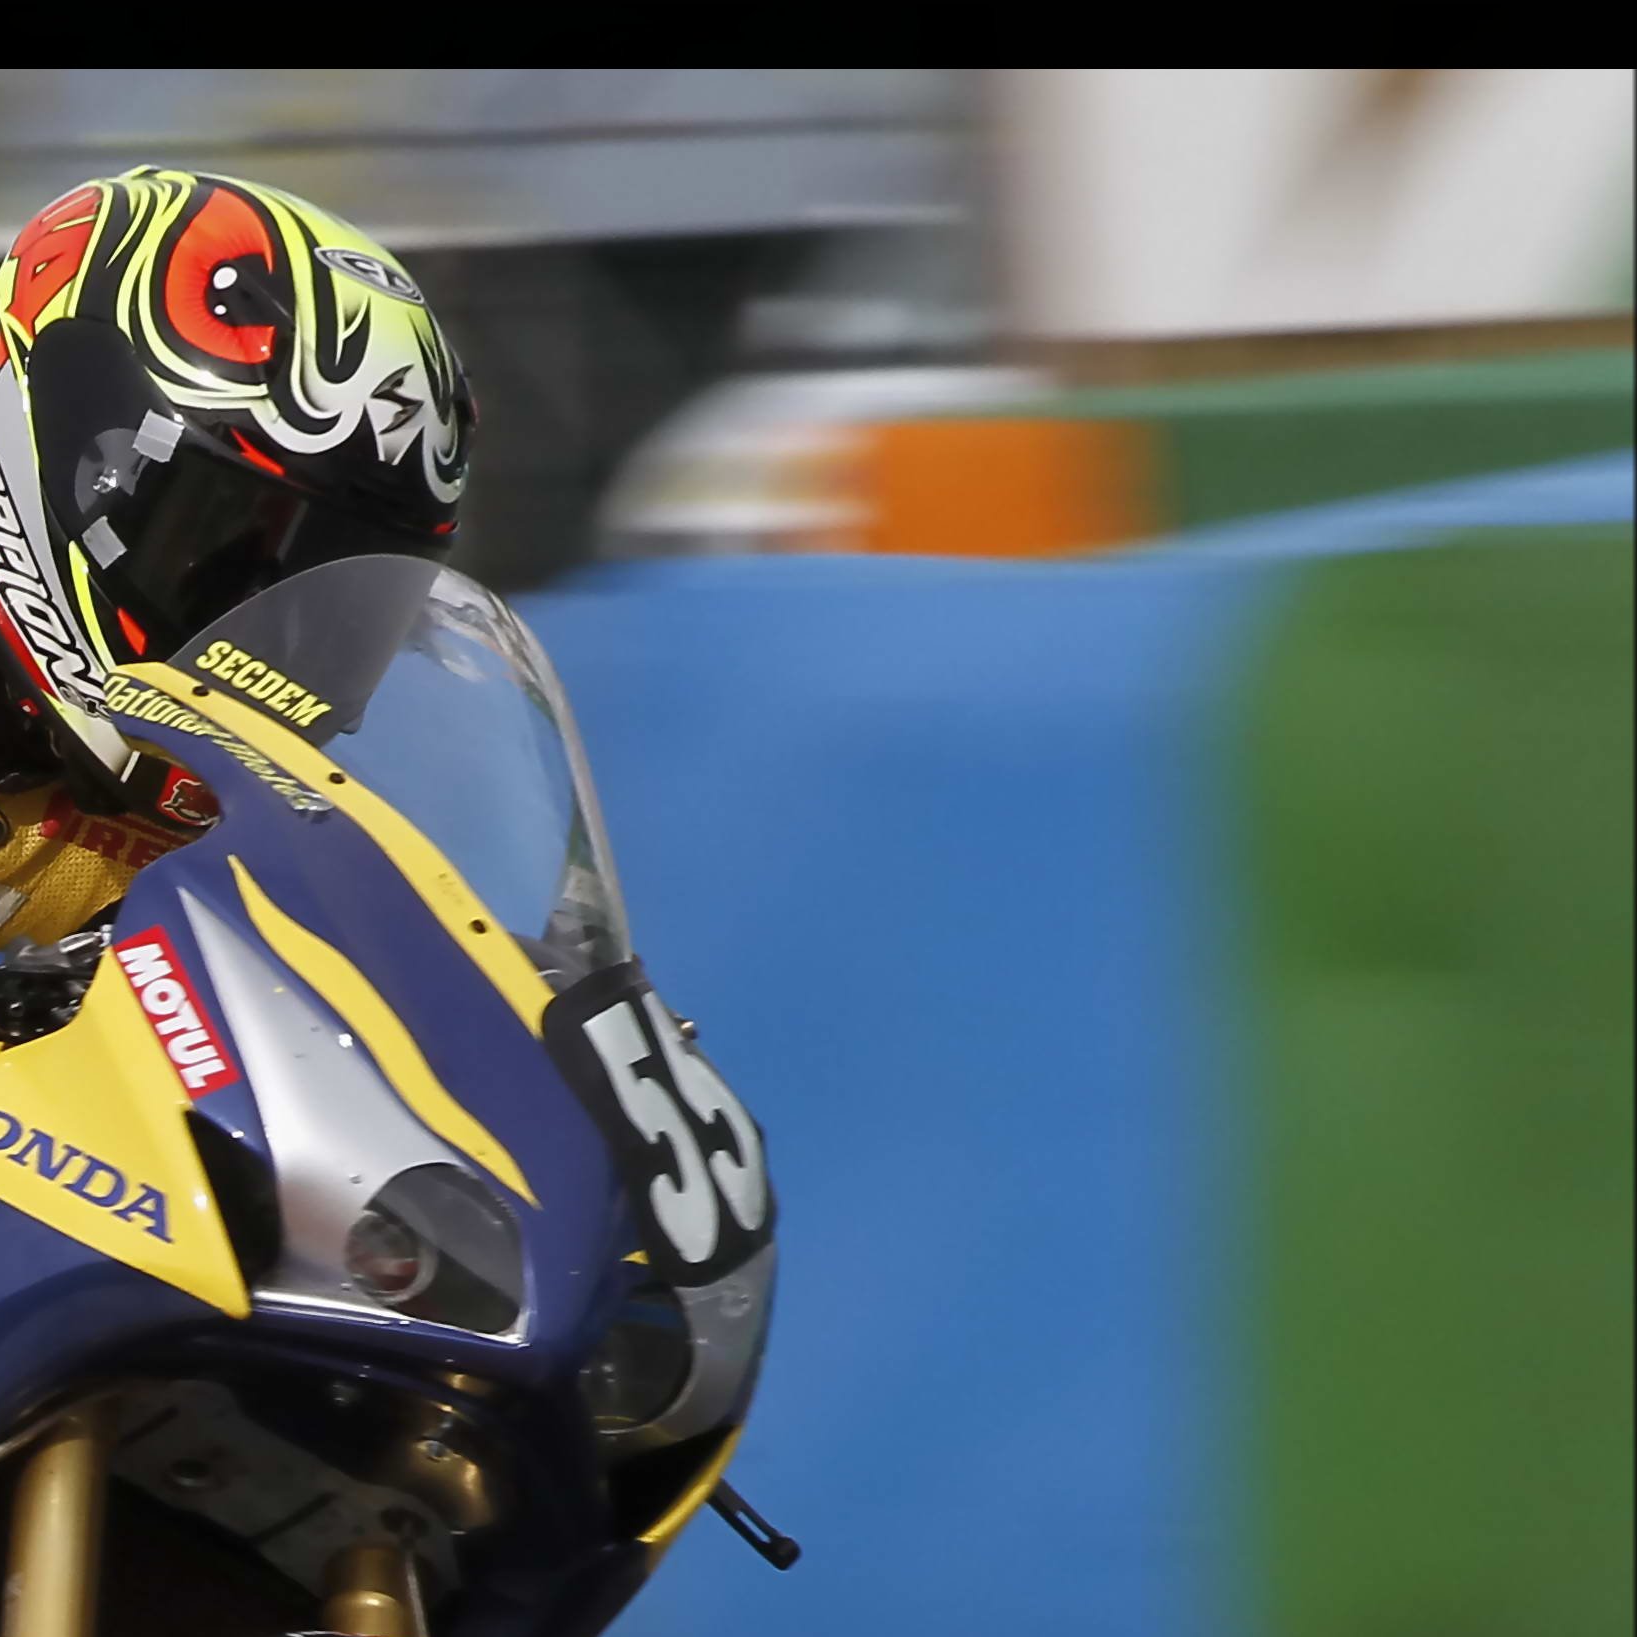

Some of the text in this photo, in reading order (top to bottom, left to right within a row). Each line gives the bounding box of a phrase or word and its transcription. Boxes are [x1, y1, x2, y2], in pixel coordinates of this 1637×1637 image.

[195, 640, 333, 729] SECDEM
[119, 942, 228, 1090] MOTUL
[581, 988, 768, 1264] 55
